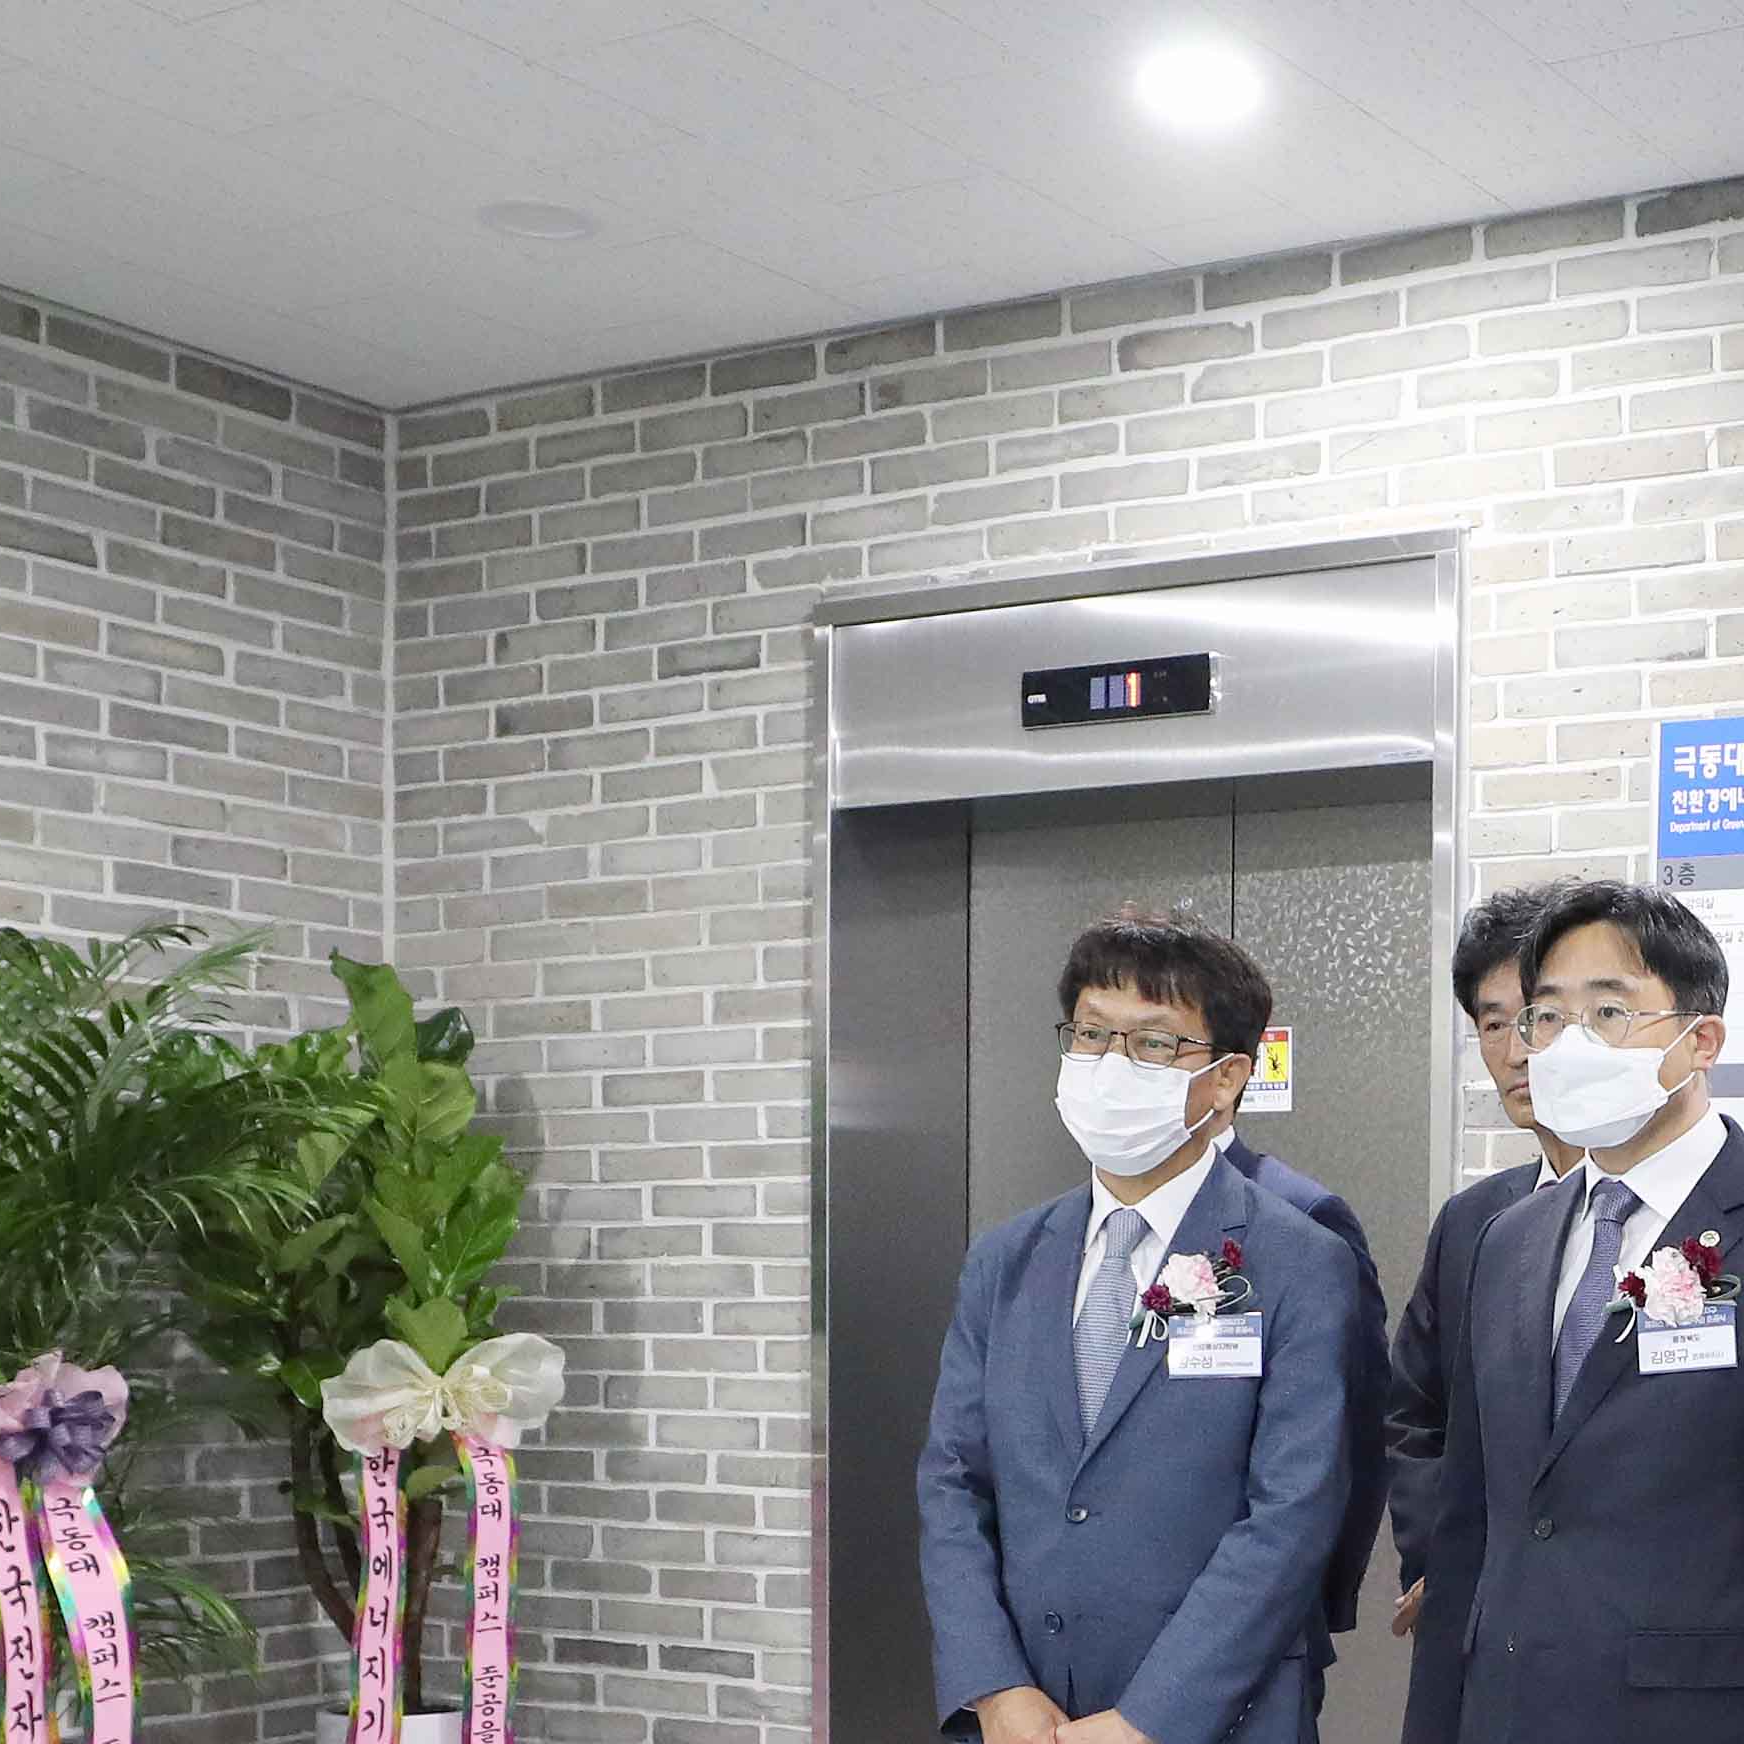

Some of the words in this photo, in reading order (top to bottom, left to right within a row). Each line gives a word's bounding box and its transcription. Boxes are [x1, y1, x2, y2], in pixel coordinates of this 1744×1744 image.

[1126, 672, 1137, 708] 1
[472, 1446, 504, 1522] 극동대
[48, 1496, 100, 1578] 극동대
[83, 1610, 127, 1703] 캠퍼스
[476, 1553, 503, 1634] 캠퍼스
[473, 1664, 504, 1744] 준공을
